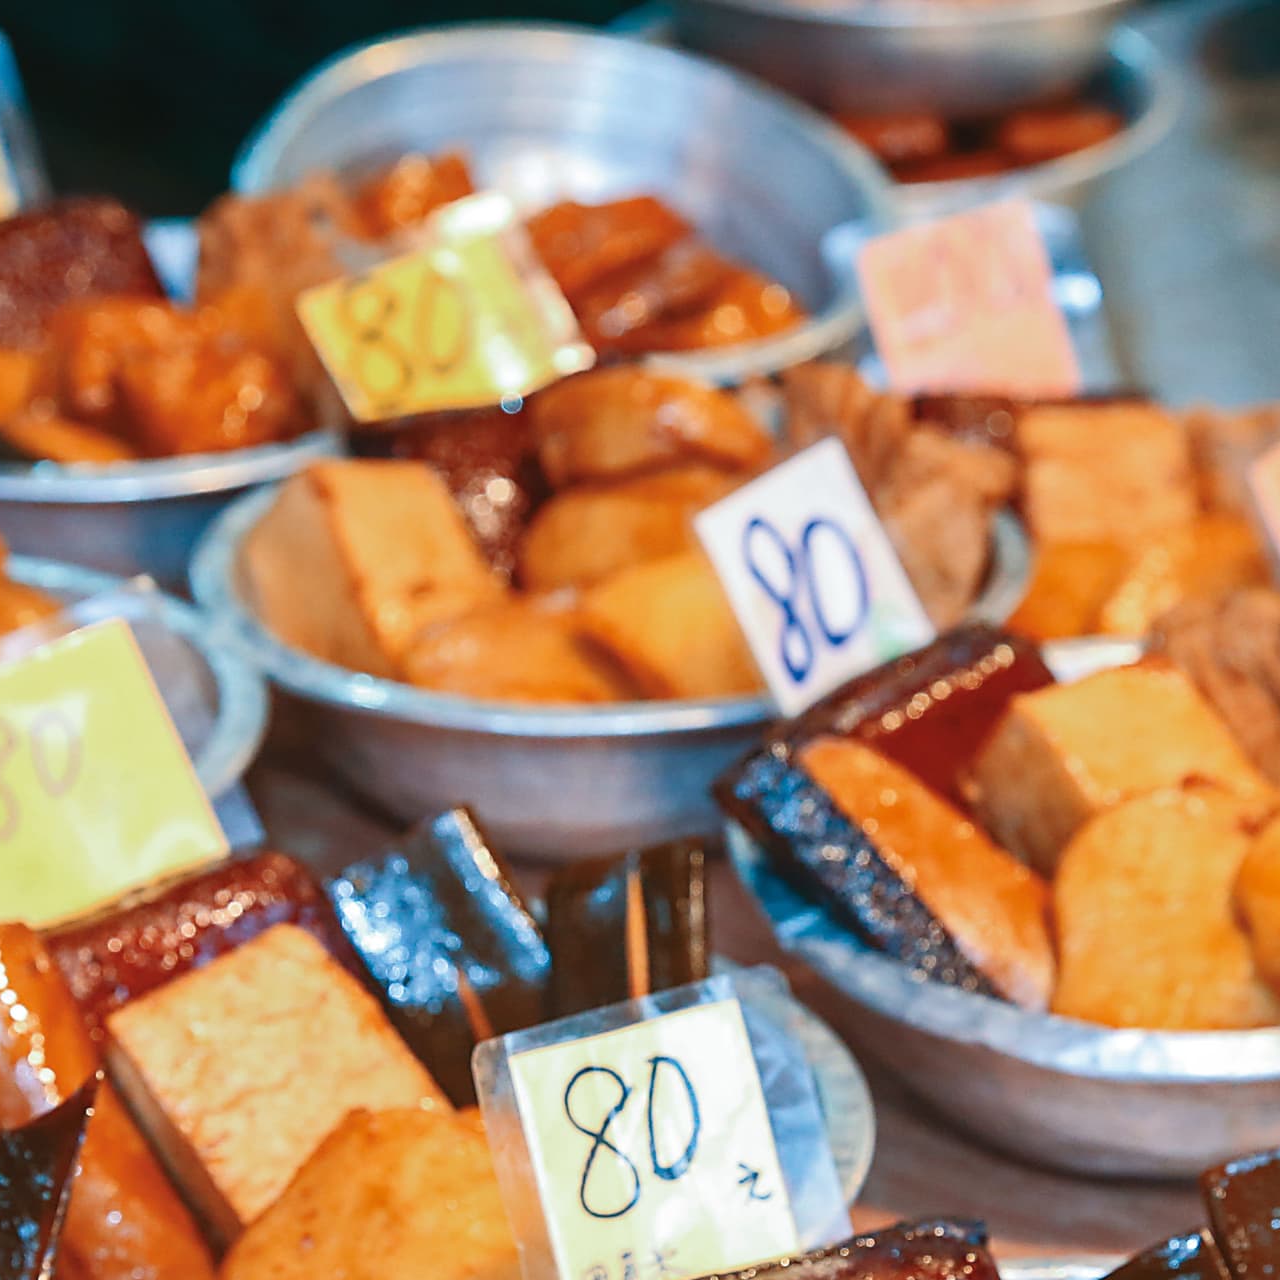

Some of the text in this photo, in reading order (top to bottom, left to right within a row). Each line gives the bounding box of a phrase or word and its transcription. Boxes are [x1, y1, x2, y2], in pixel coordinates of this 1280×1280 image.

[337, 270, 470, 397] 80
[743, 516, 868, 682] 80
[565, 1056, 701, 1218] 80
